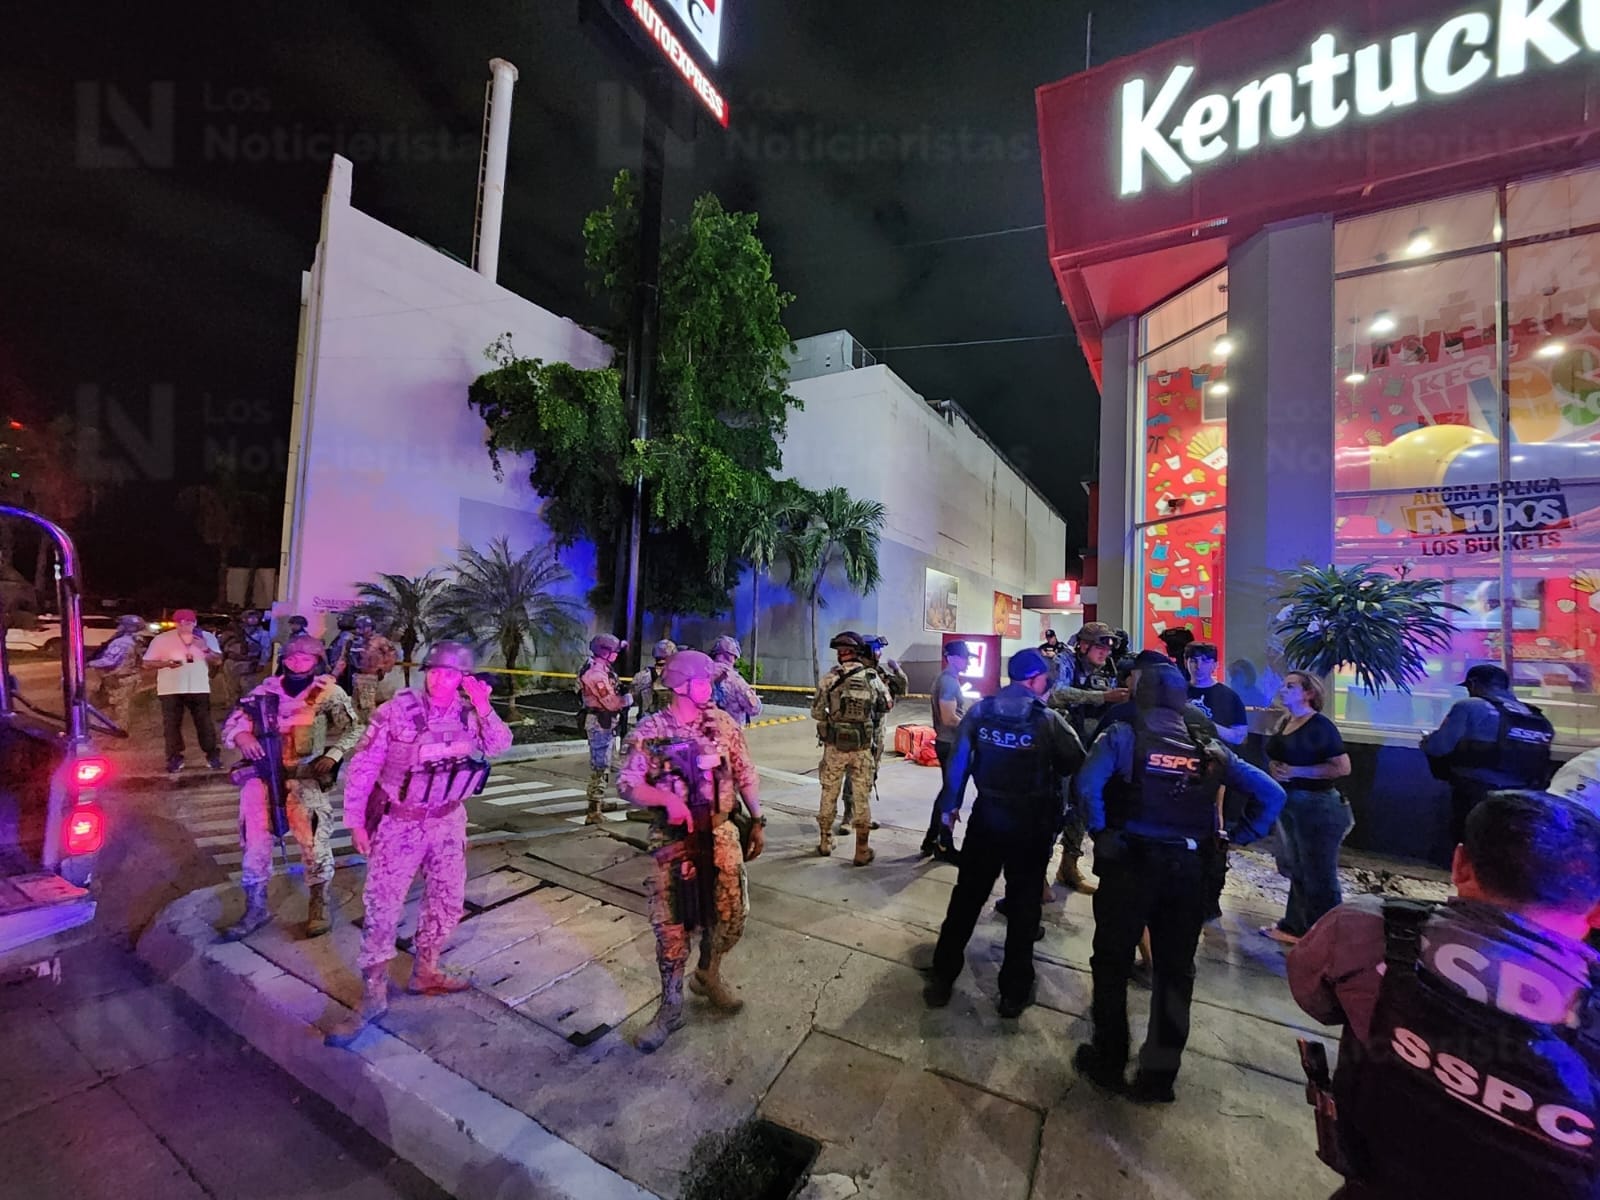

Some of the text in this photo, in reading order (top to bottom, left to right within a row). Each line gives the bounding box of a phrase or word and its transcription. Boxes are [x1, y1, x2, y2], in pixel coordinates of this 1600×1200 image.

[1120, 0, 1600, 196] Kentuck
[1412, 477, 1561, 506] AHORA APLICA
[1415, 498, 1564, 534] EN TODOS
[1422, 531, 1562, 557] LOS BUCKETS
[1508, 727, 1552, 743] SSPC
[1148, 753, 1200, 771] SSPC
[1391, 1027, 1595, 1146] SSPC
